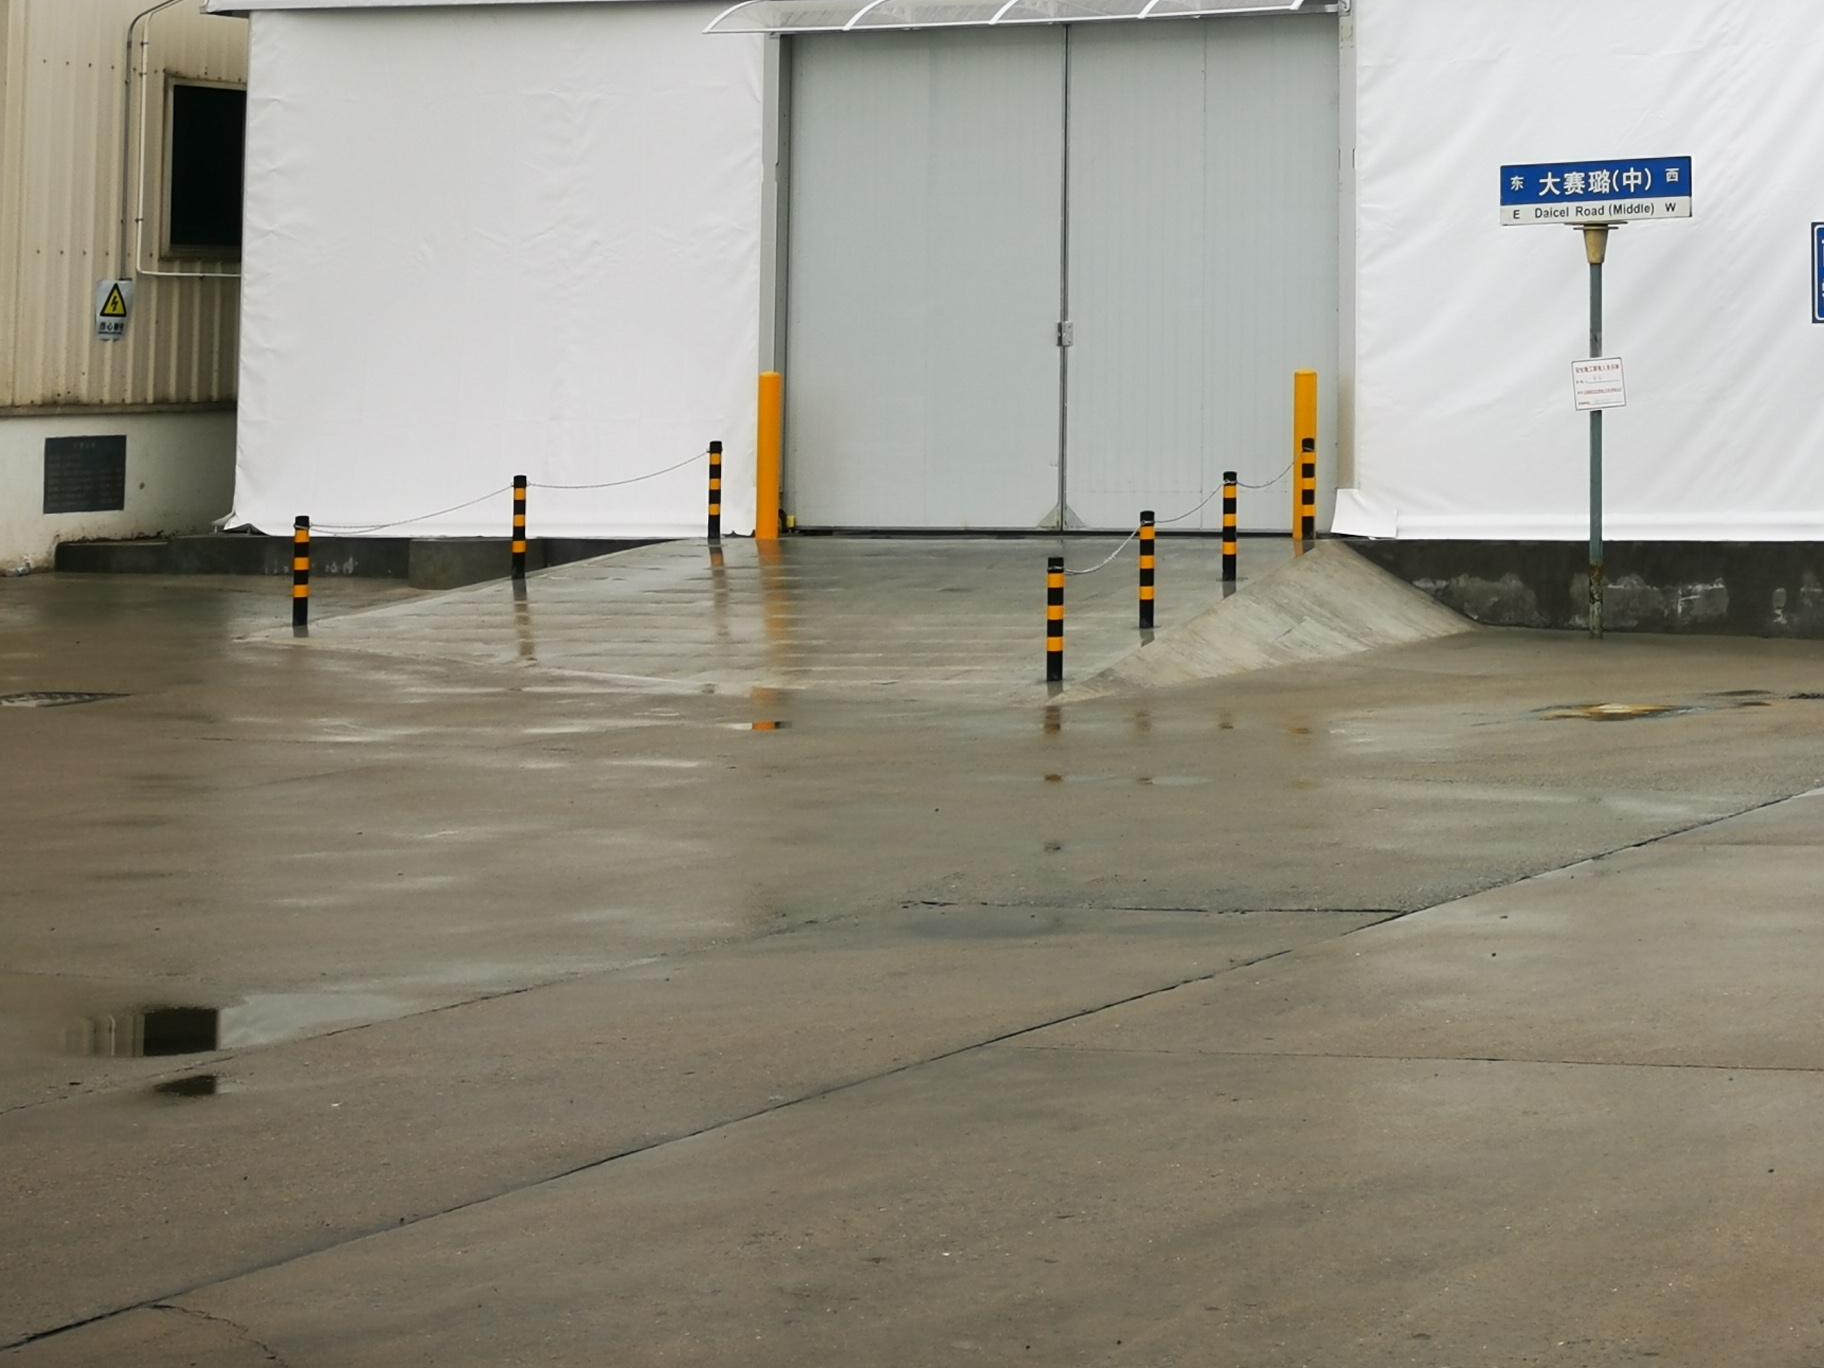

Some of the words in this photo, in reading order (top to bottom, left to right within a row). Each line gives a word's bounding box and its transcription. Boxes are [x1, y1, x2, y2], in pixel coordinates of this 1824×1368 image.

[1510, 175, 1524, 191] 东
[1664, 167, 1680, 182] 西
[1513, 209, 1520, 219] E
[1534, 207, 1569, 219] Daicel
[1575, 205, 1605, 217] Road
[1608, 202, 1655, 216] (Middle)
[1664, 202, 1677, 212] W
